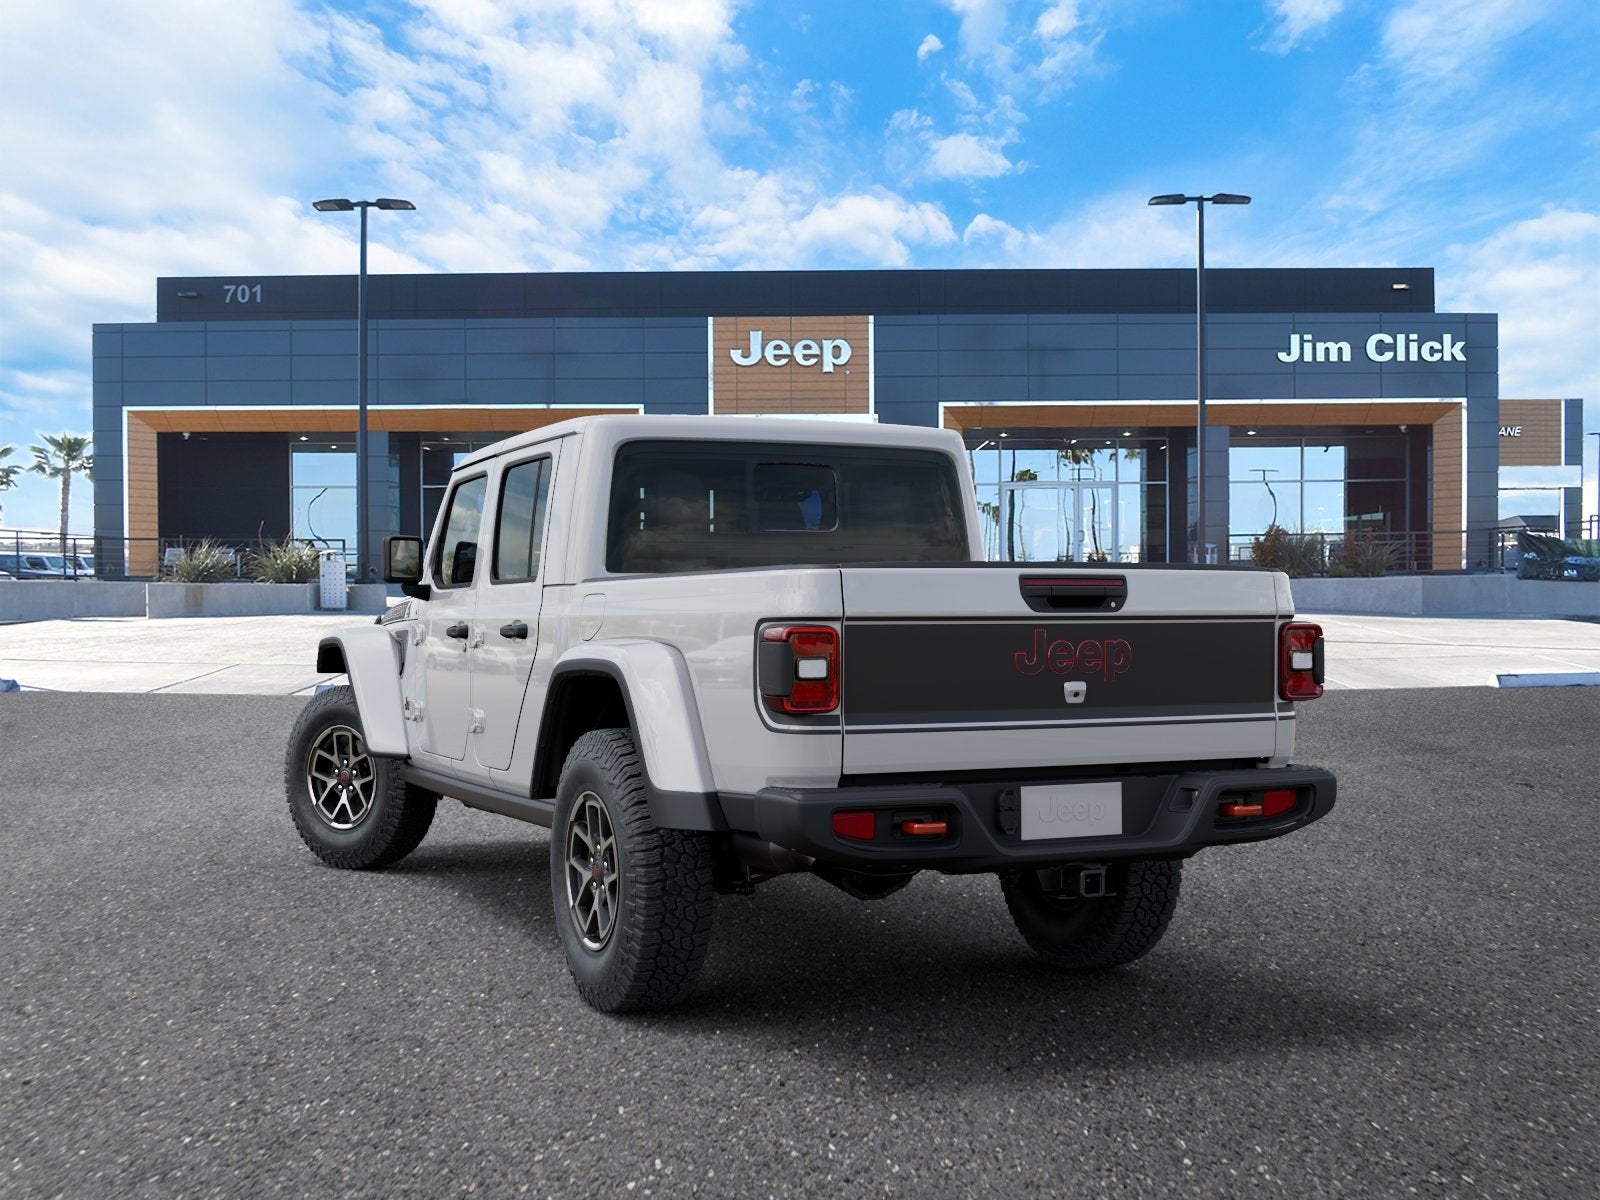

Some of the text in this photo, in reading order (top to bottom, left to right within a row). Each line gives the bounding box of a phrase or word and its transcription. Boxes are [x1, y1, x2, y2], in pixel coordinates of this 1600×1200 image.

[223, 284, 262, 304] 701
[729, 329, 853, 374] Jeep
[1277, 333, 1467, 363] Jim Click
[1013, 628, 1133, 683] Jeep
[1038, 793, 1106, 826] Jeep
